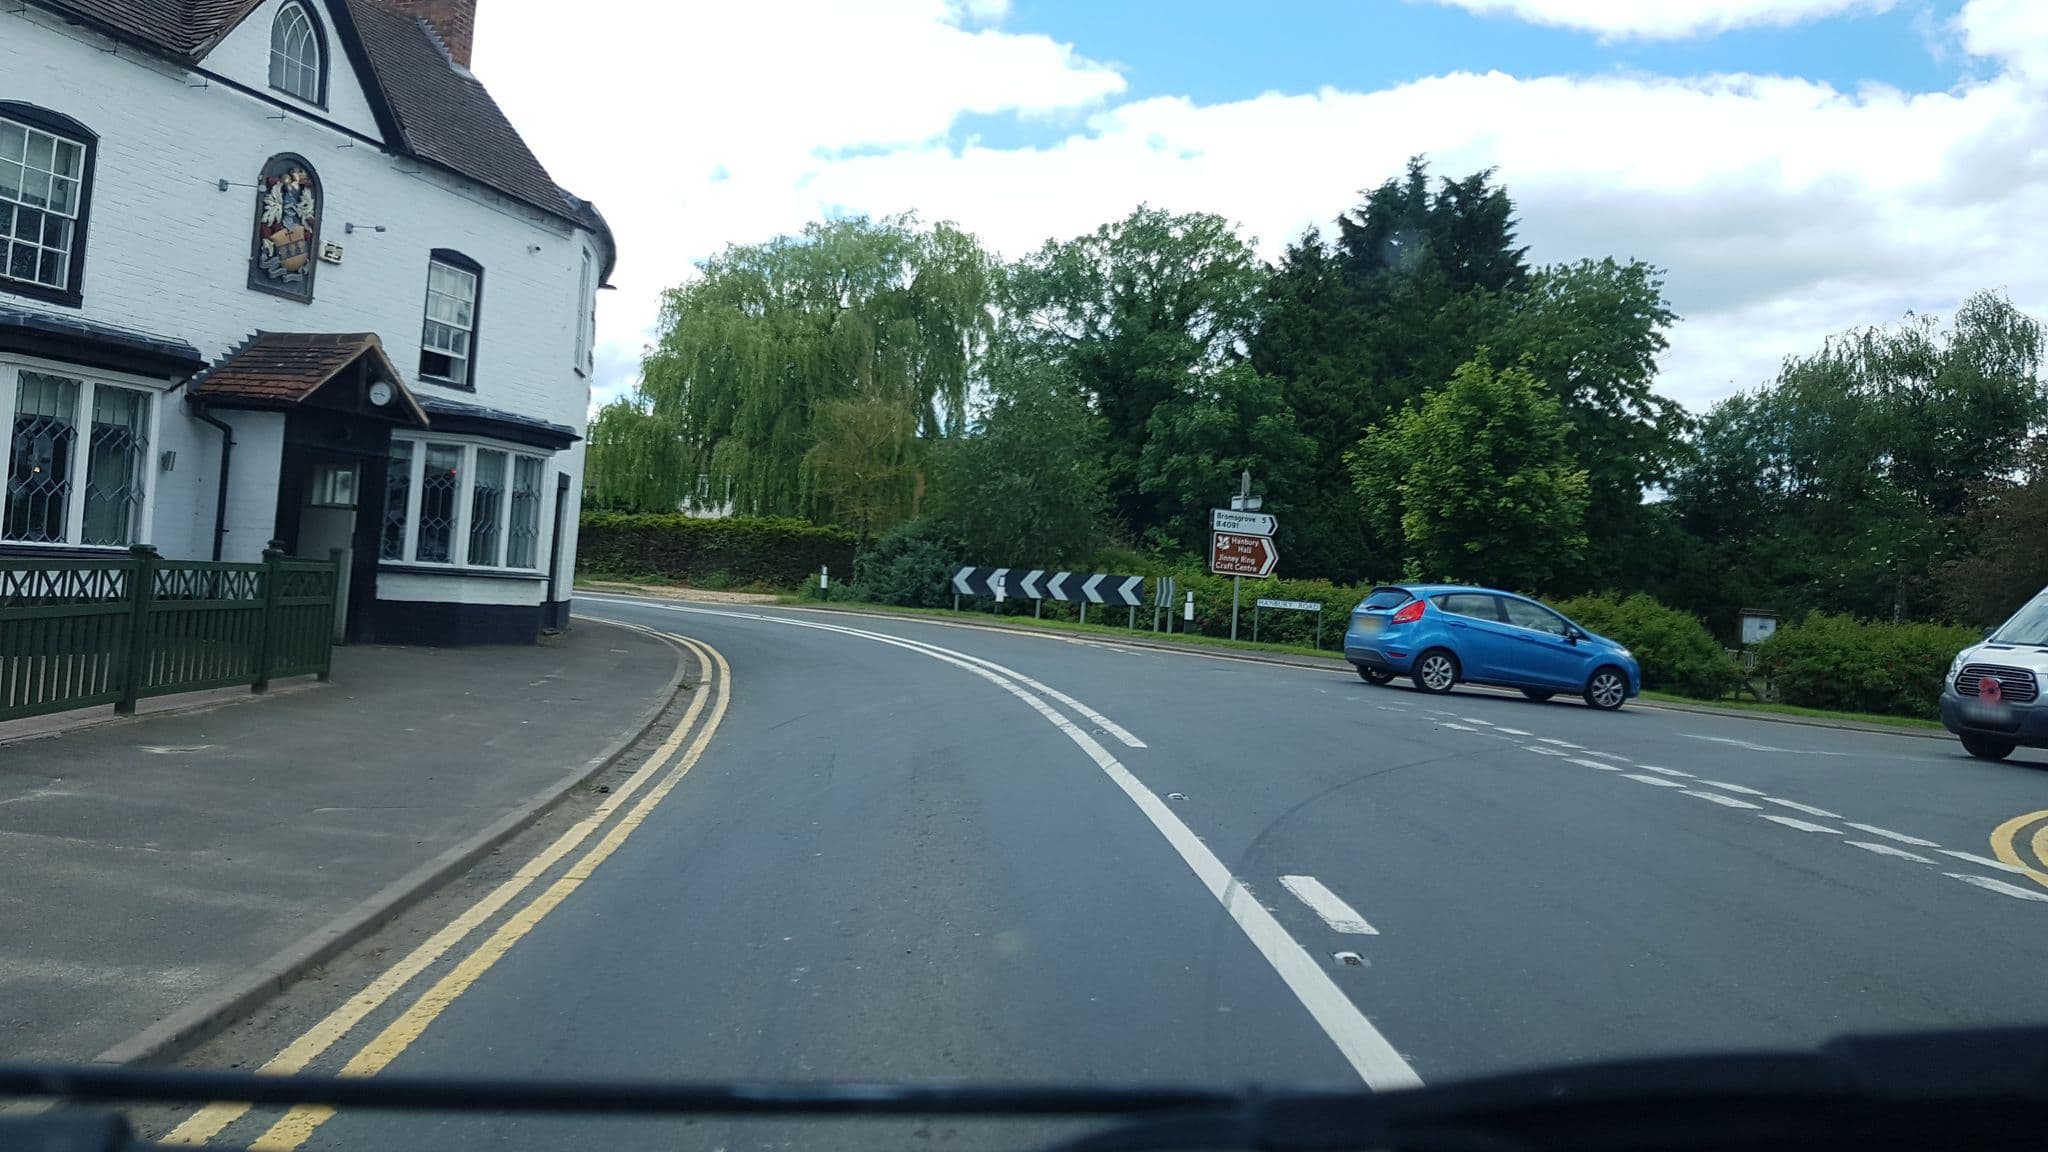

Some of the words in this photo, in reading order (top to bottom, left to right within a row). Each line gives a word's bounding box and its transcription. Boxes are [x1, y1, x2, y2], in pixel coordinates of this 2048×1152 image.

[1217, 512, 1256, 522] Bromsgrove
[1231, 537, 1259, 547] Hanbury
[1218, 554, 1239, 563] Jinney
[1240, 555, 1256, 565] Ring
[1234, 563, 1257, 572] Centre
[1258, 599, 1292, 608] HANBURY
[1298, 602, 1319, 610] ROAD
